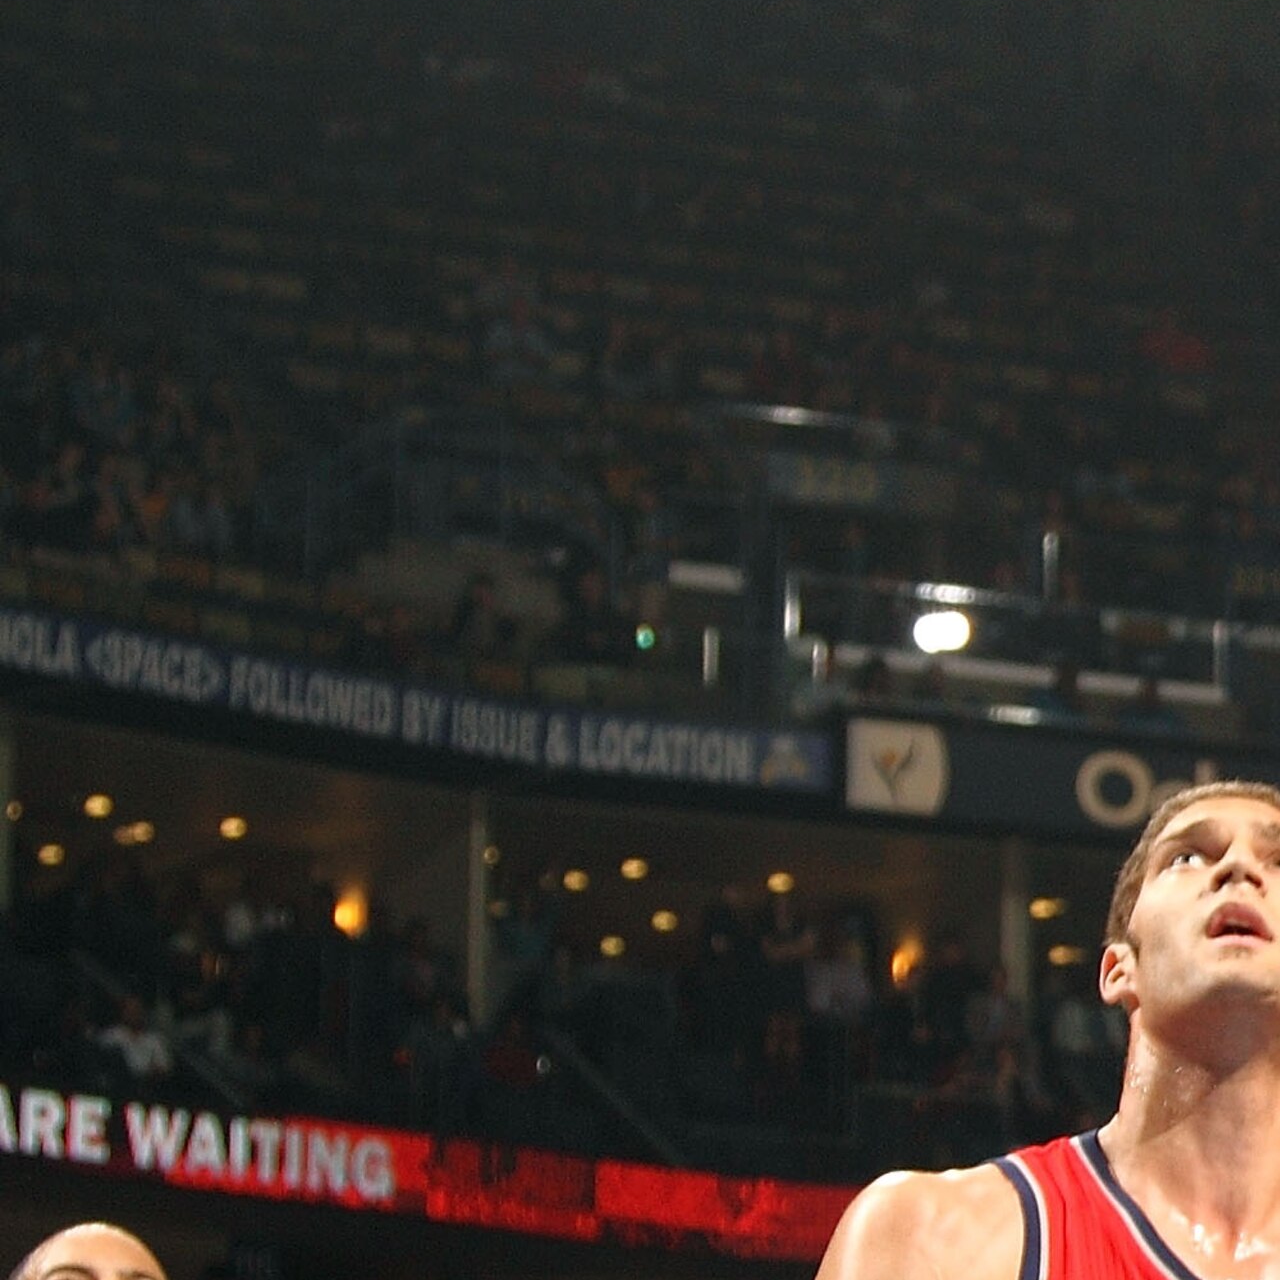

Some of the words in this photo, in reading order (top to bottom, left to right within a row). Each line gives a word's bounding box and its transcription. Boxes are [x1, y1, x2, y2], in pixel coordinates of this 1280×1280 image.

[228, 655, 396, 737] FOLLOWED
[402, 688, 444, 747] BY
[450, 698, 539, 764] ISSUE
[544, 712, 572, 770] &
[579, 714, 756, 785] LOCATION
[125, 1101, 395, 1201] WAITING
